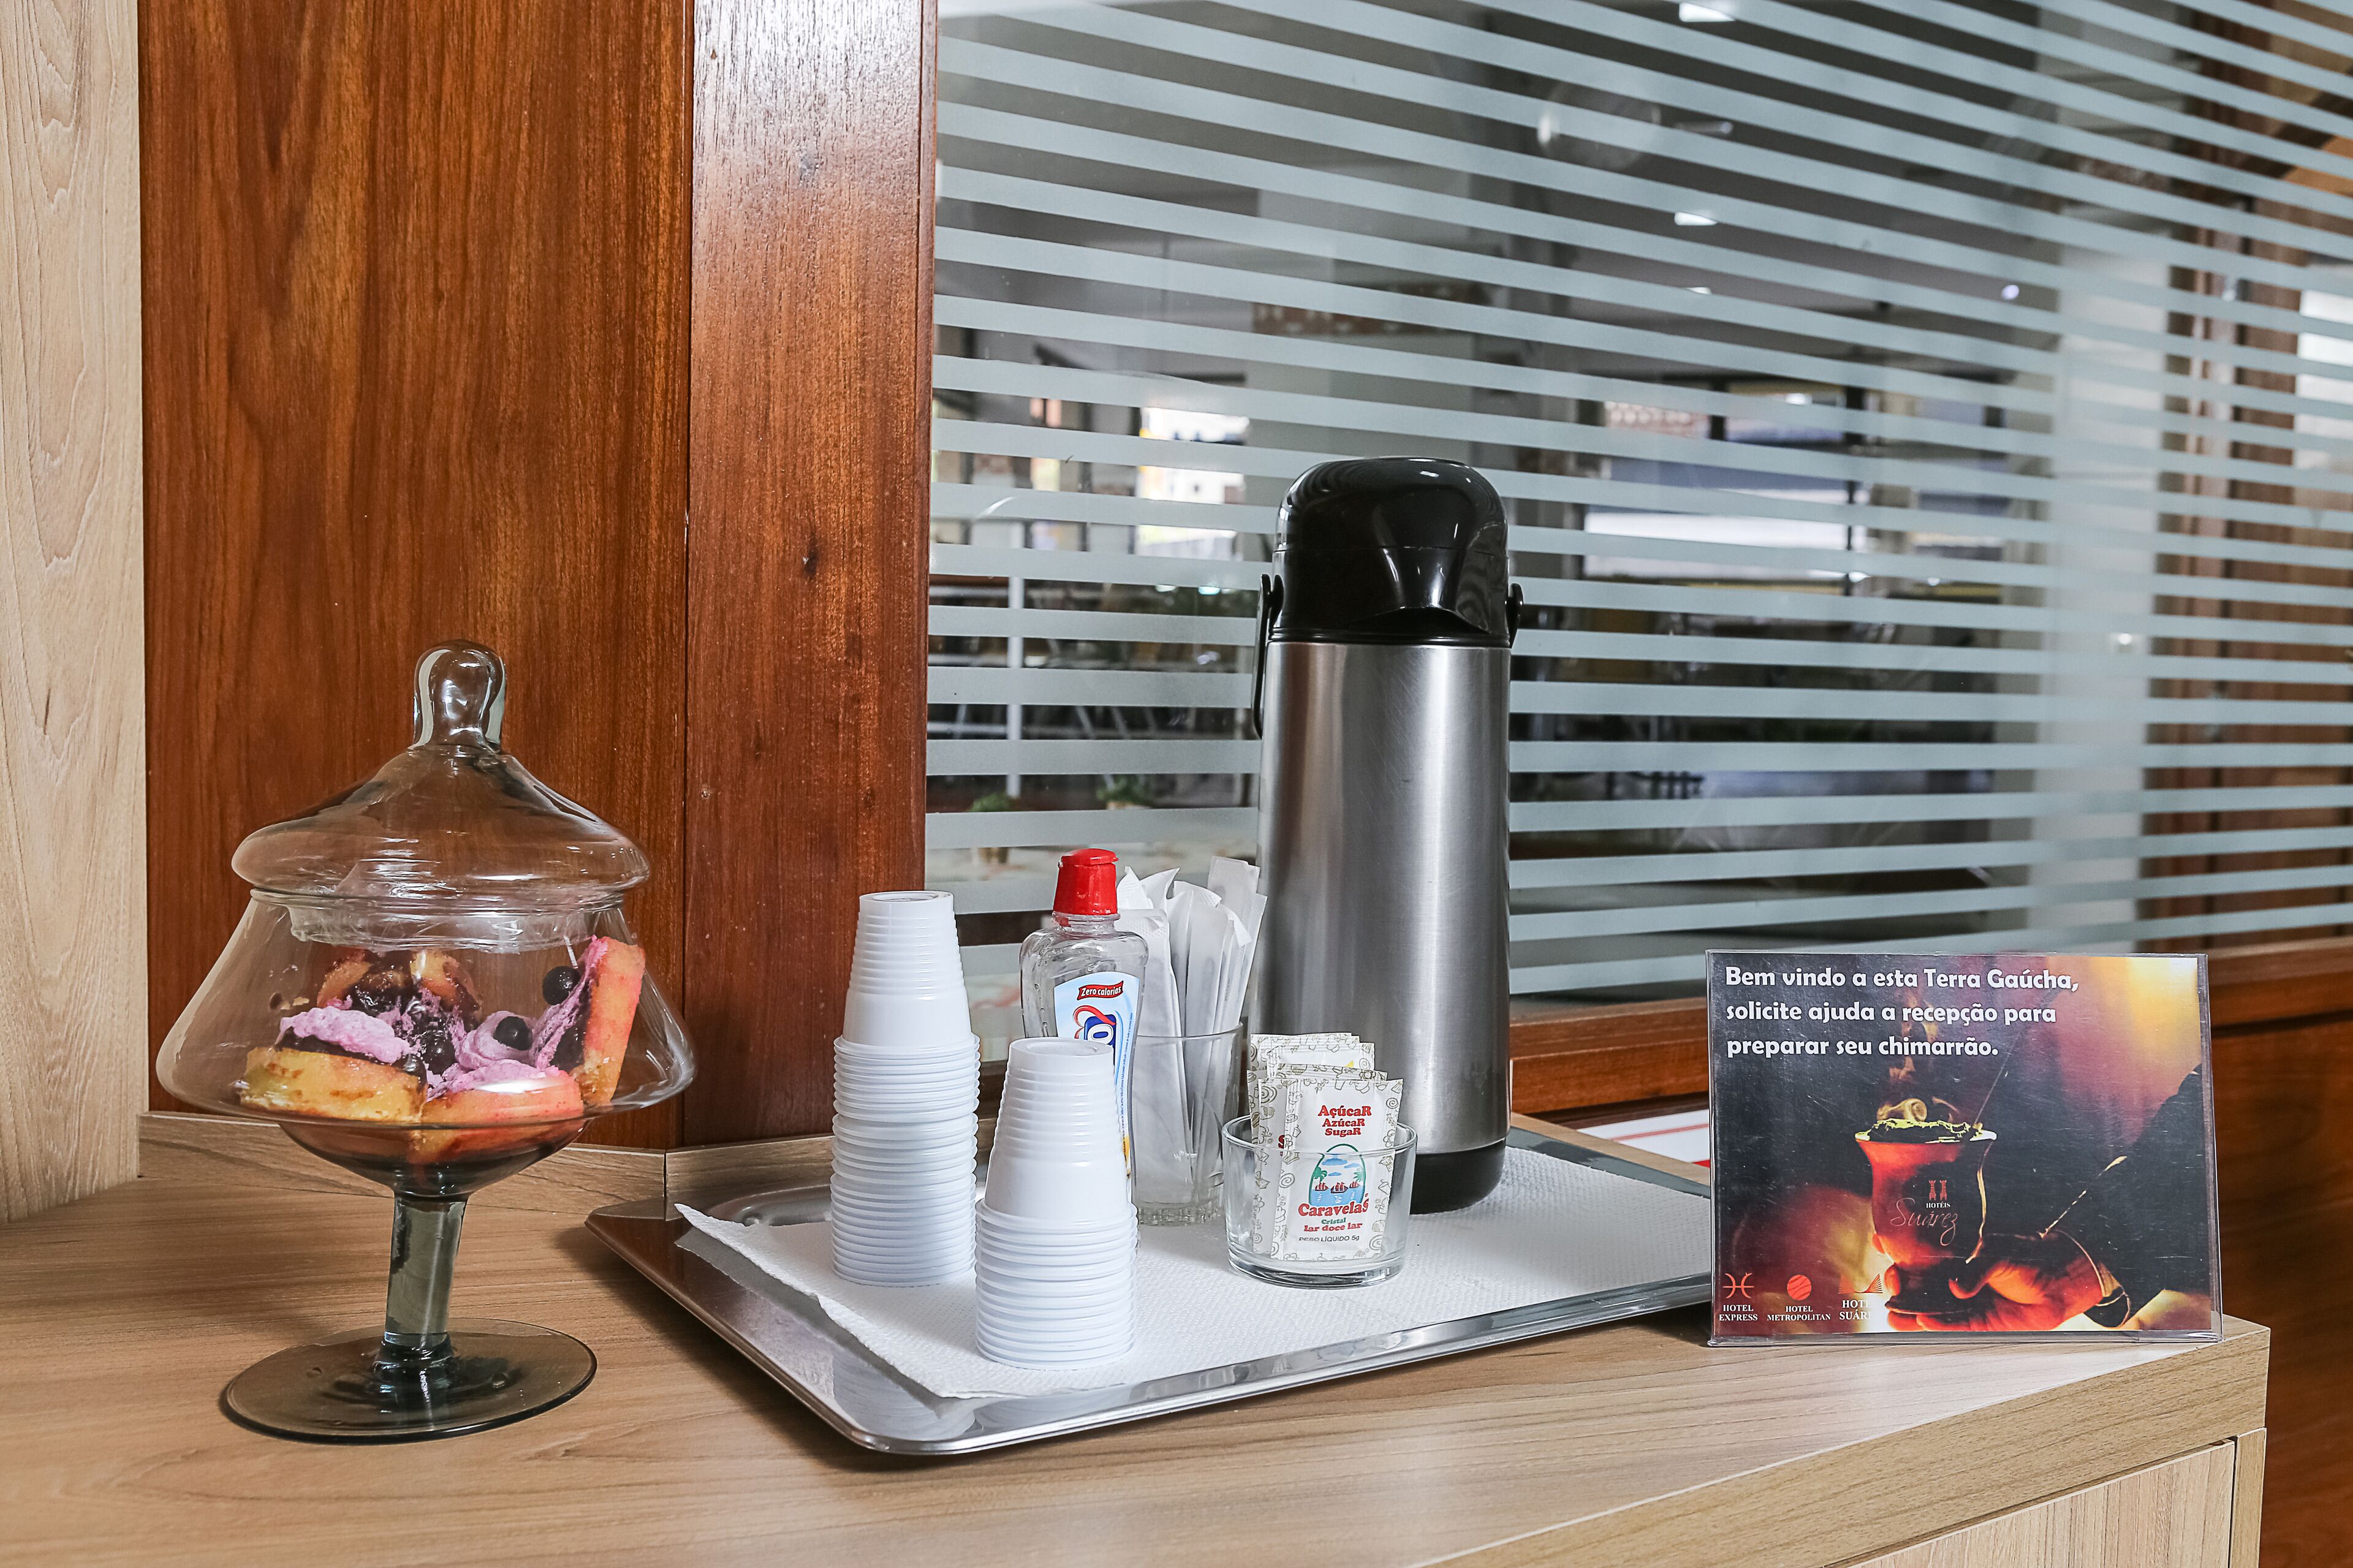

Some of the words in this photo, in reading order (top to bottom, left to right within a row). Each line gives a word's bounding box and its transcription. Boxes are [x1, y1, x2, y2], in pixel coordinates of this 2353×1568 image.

[1080, 987, 1097, 997] Zero
[1097, 986, 1121, 996] calorias
[1726, 966, 1776, 986] Bem
[1782, 967, 1846, 987] vindo
[1852, 972, 1867, 987] a
[1873, 969, 1918, 987] esta
[1923, 968, 1981, 988] Terra
[1987, 968, 2079, 992] Gaúcha,
[1726, 1001, 1802, 1020] solicite
[1808, 1001, 1875, 1023] ajuda
[1881, 1006, 1896, 1020] a
[1902, 1002, 1998, 1026] recepção
[2004, 1007, 2056, 1026] para
[1727, 1040, 1830, 1058] preparar
[1836, 1040, 1873, 1055] seu
[1878, 1036, 1999, 1056] chimarrão.
[1890, 1197, 1958, 1246] Suárez
